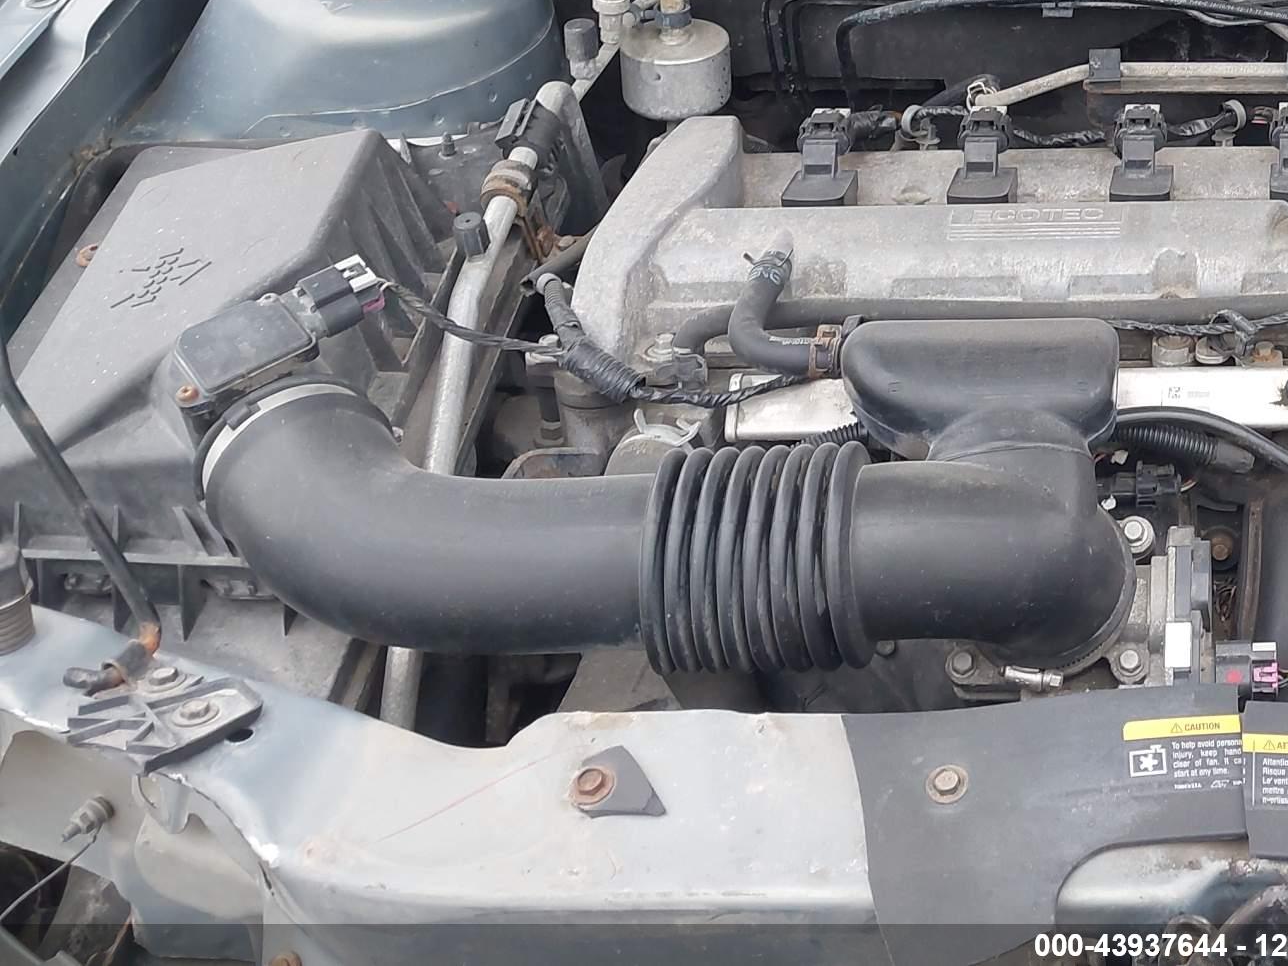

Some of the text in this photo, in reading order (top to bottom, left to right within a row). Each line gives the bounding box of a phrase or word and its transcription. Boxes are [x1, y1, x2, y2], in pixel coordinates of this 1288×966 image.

[971, 208, 1105, 224] ECOTEC
[1184, 722, 1221, 732] CAUTION
[1171, 741, 1180, 749] To
[1262, 767, 1286, 776] Risque
